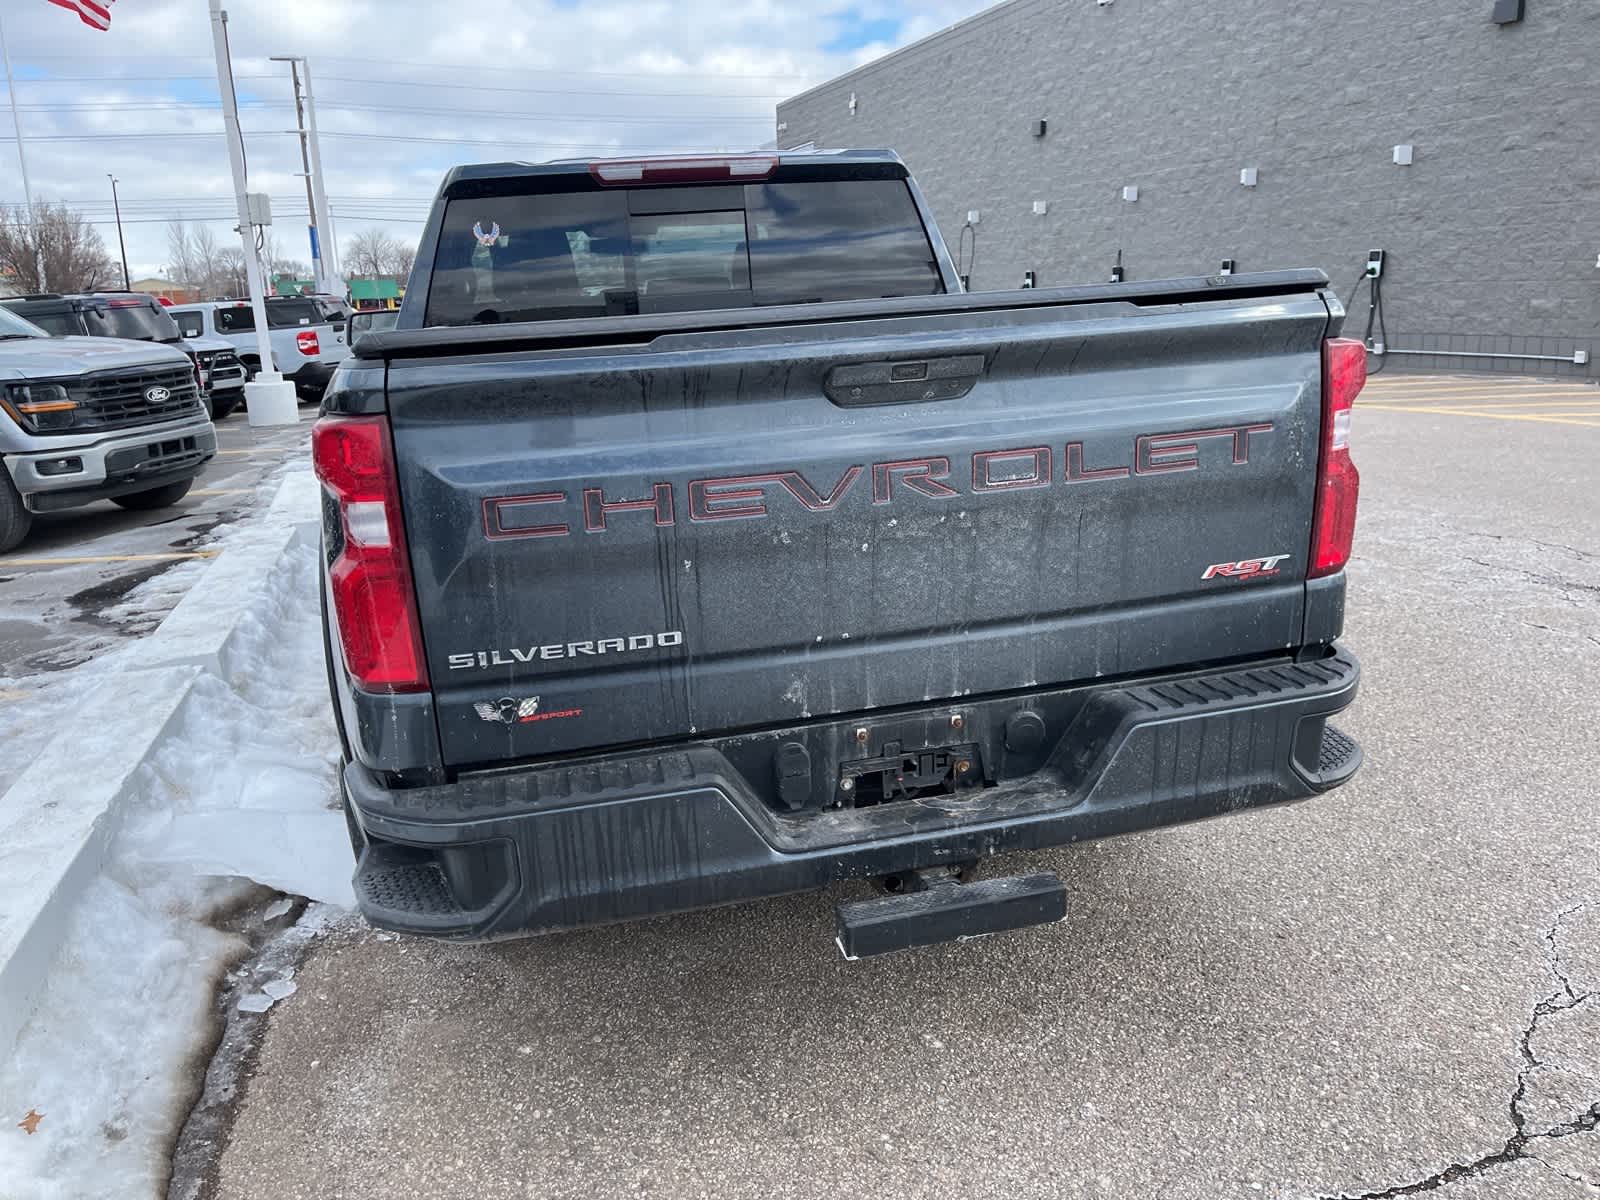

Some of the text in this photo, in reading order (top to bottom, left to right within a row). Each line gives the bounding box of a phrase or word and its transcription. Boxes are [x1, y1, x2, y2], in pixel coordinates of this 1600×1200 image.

[481, 423, 1275, 542] CHEVROLET
[1200, 553, 1291, 580] RST
[448, 630, 683, 670] SILVERADO
